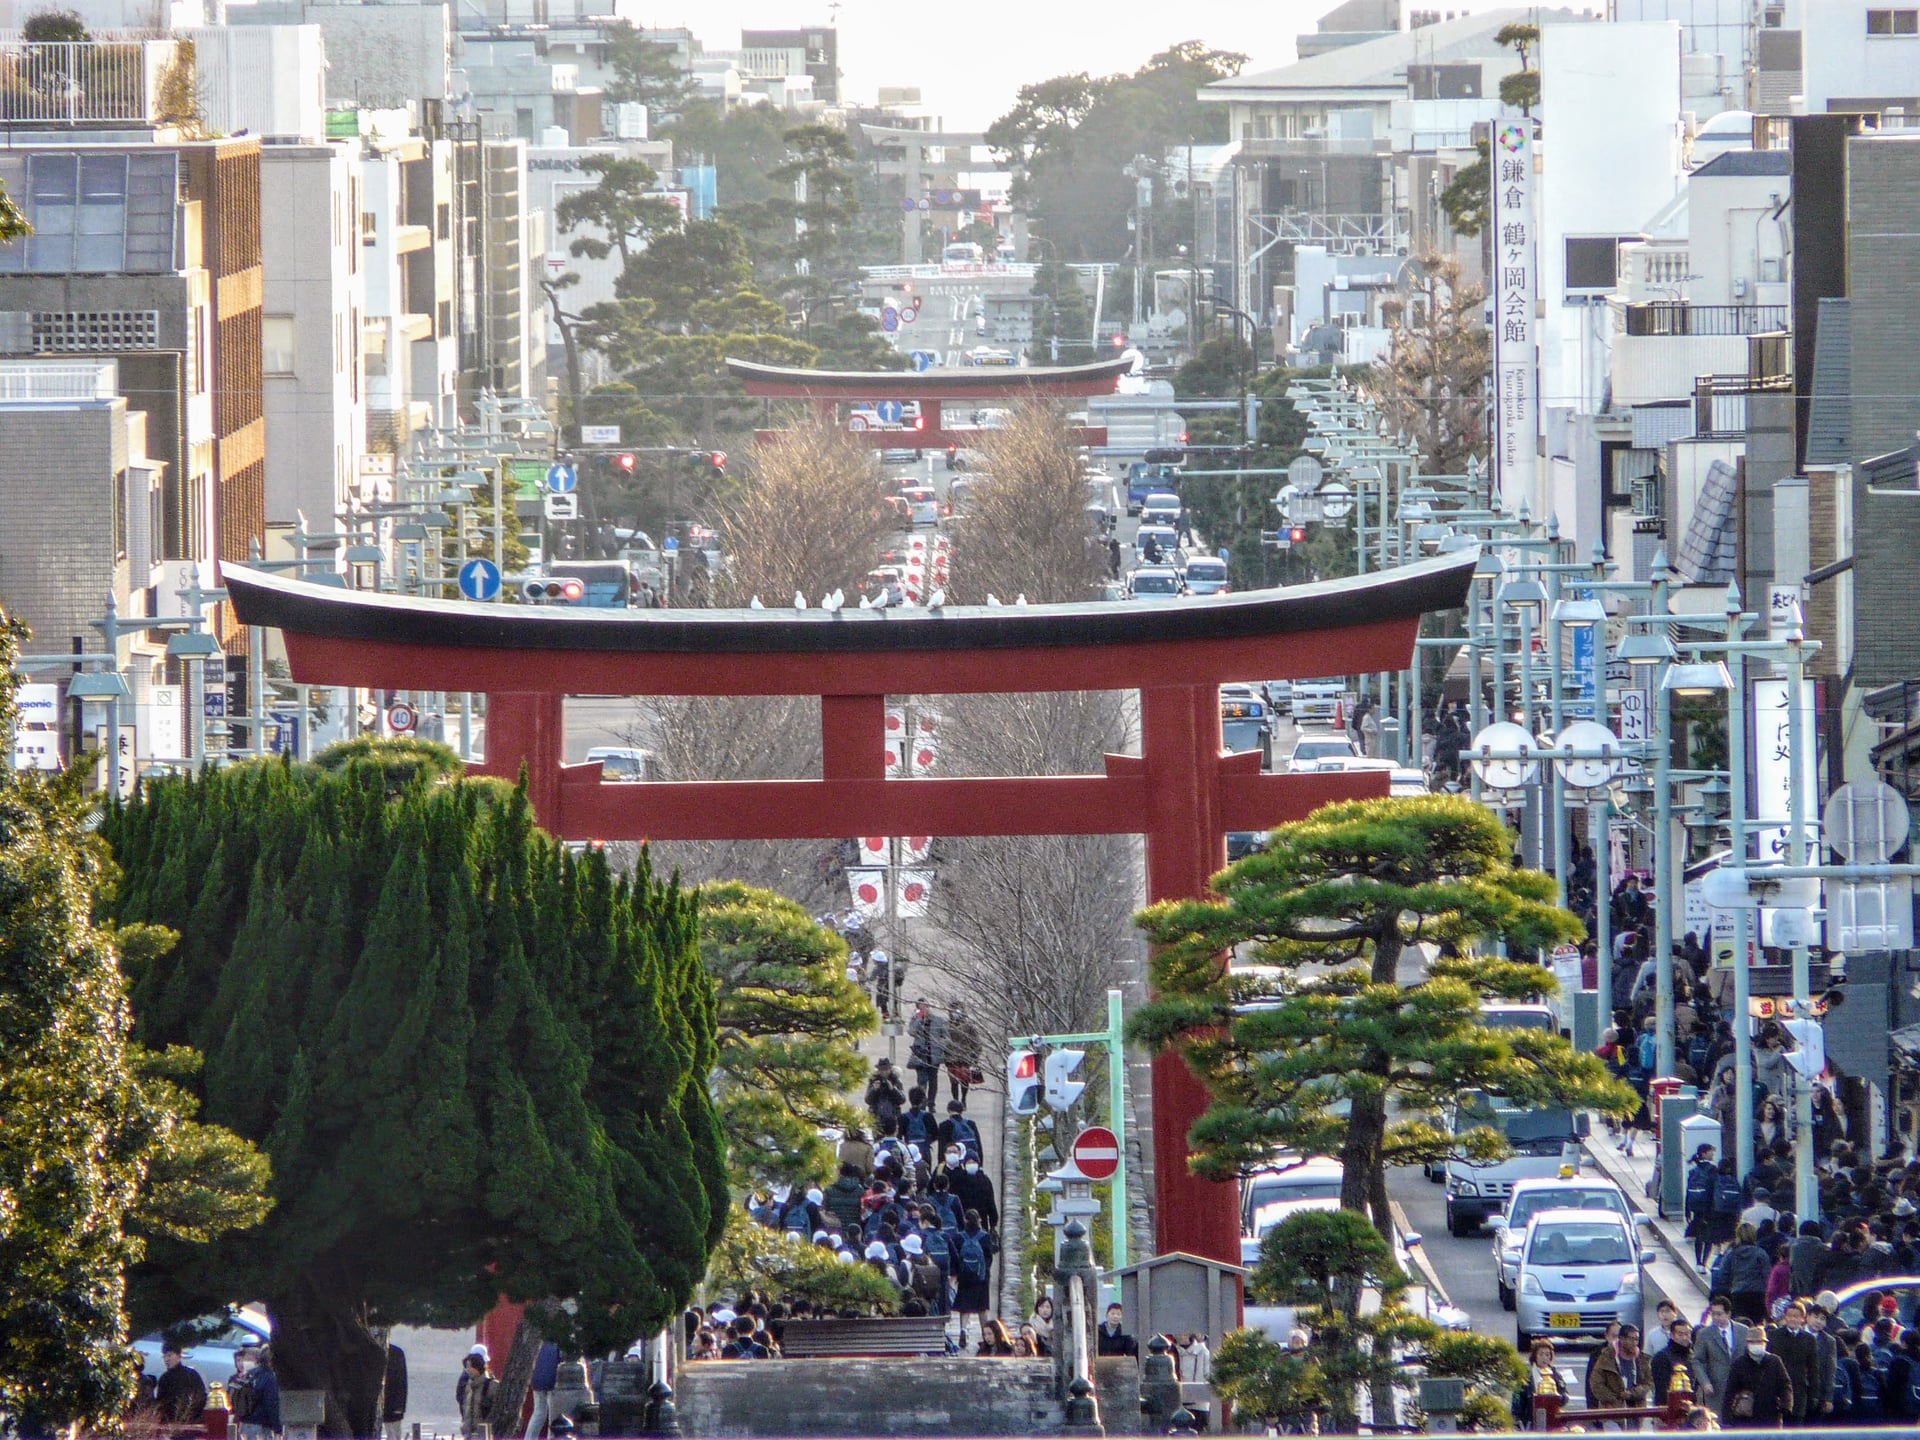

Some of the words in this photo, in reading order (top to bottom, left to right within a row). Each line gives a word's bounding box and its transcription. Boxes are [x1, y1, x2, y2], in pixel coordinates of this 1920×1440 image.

[528, 159, 582, 173] patago
[1502, 158, 1525, 209] 鎌倉
[1505, 370, 1514, 428] Tsurugaoka
[1516, 368, 1525, 421] Kamakura
[1506, 432, 1515, 467] Kaikan
[18, 699, 52, 709] asonic
[393, 712, 407, 724] 40
